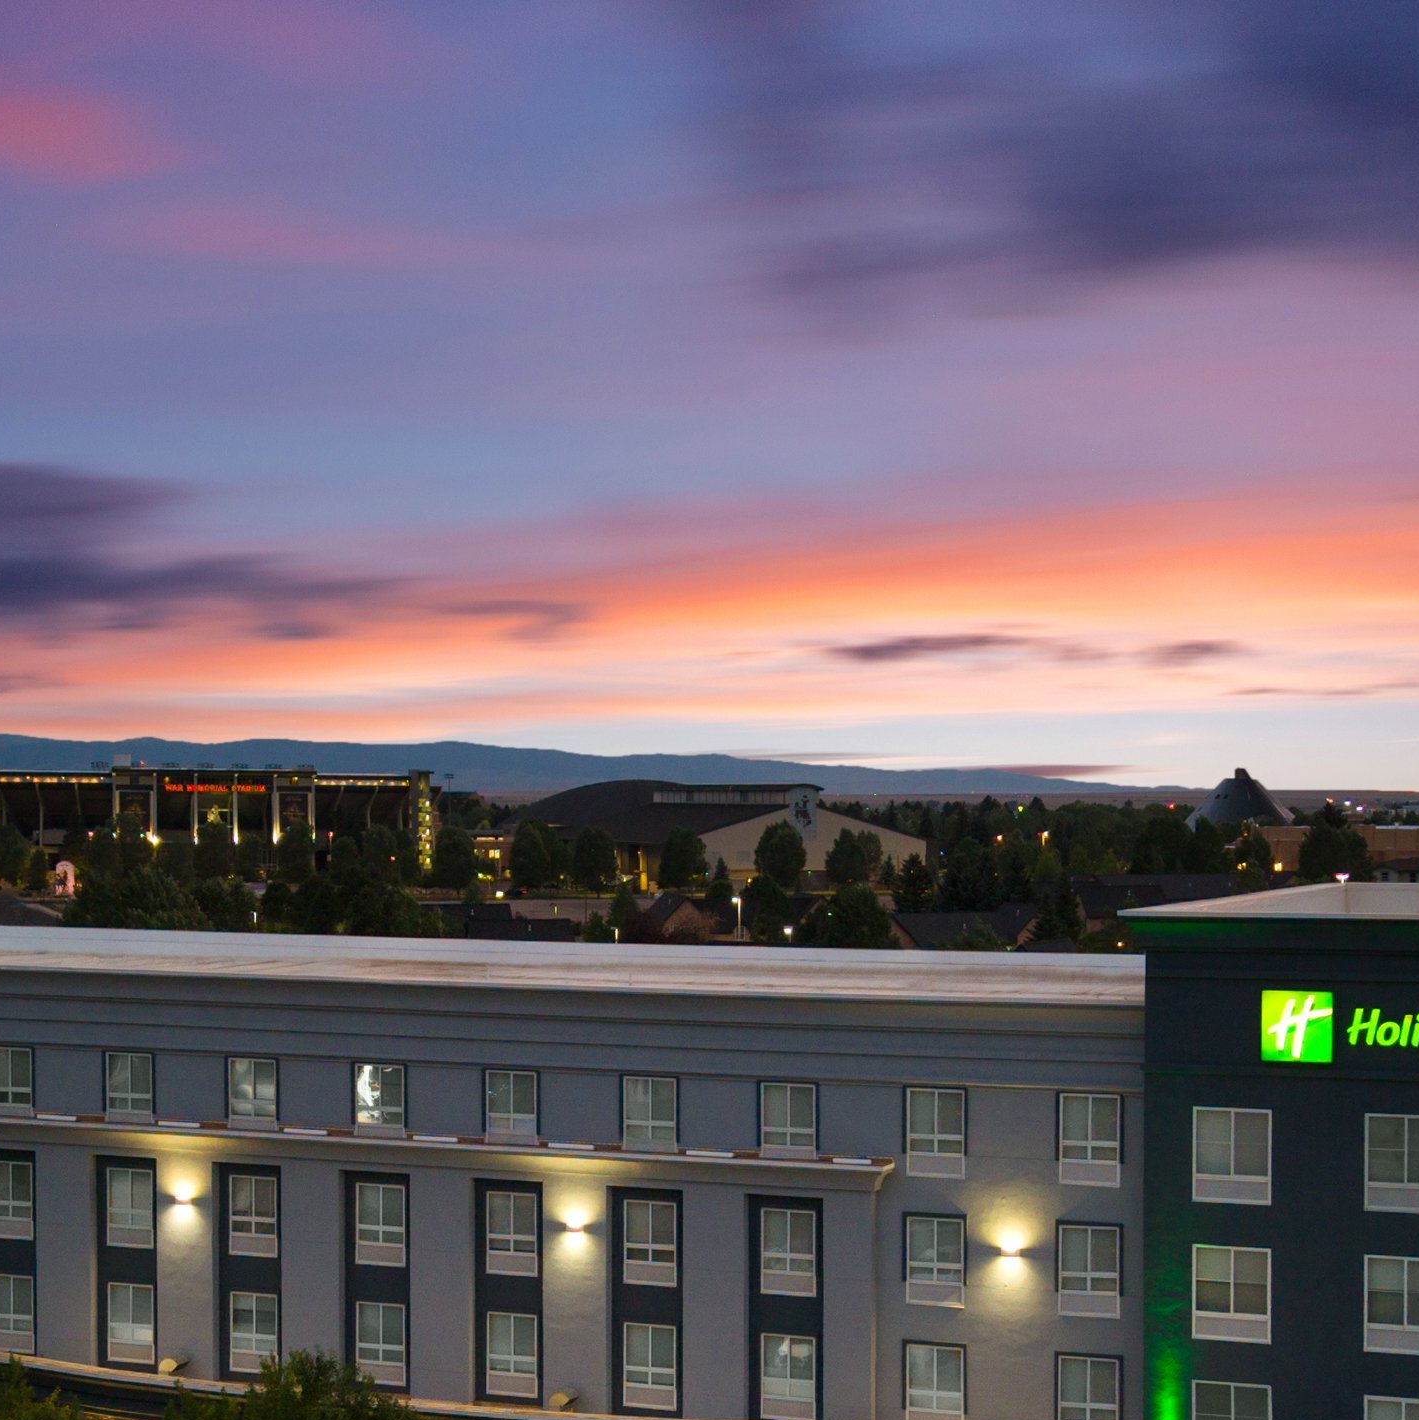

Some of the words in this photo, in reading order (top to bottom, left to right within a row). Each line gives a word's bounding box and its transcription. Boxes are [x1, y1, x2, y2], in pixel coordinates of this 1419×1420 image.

[165, 784, 183, 792] WAR
[186, 783, 228, 792] MEMORIAL
[231, 783, 266, 792] STADIUM
